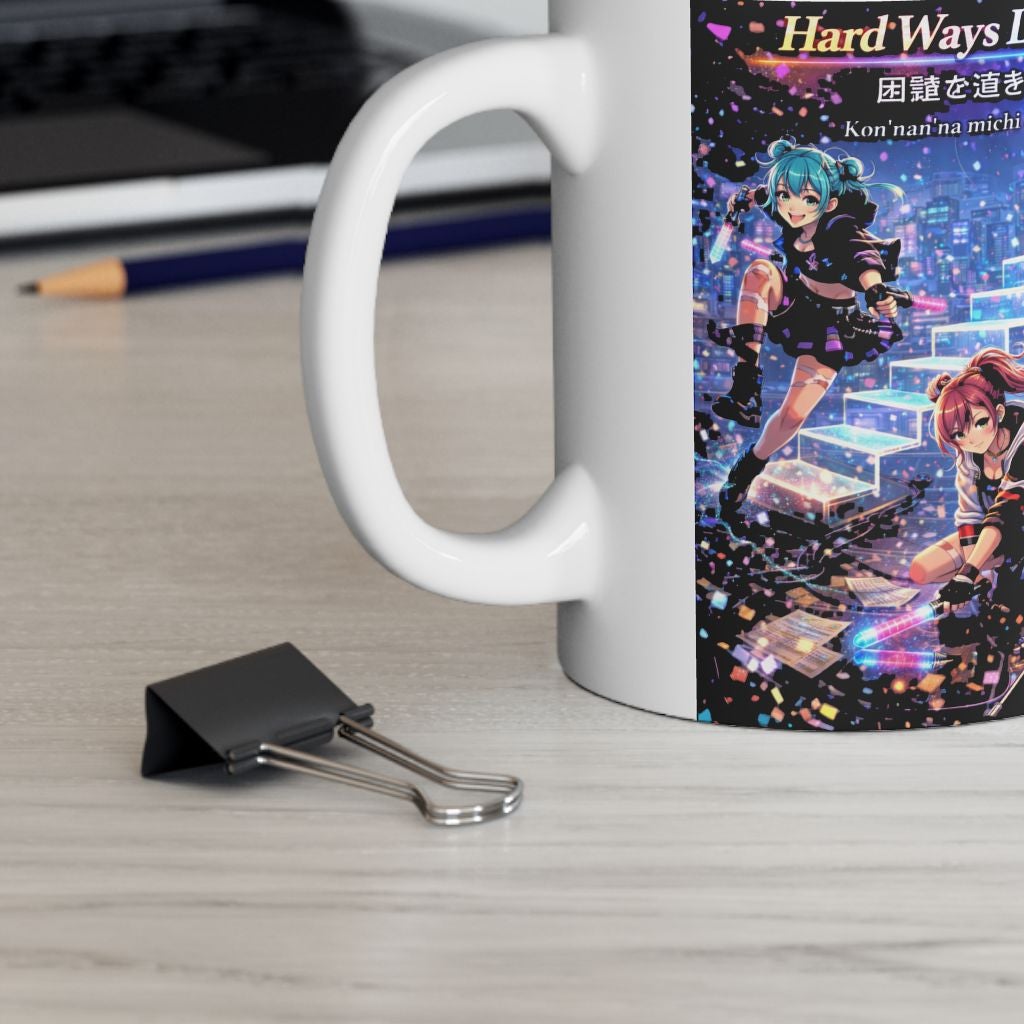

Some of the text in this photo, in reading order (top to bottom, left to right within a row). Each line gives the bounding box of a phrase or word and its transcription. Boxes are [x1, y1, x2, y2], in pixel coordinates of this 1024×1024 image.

[778, 14, 889, 53] Hard
[898, 13, 1000, 59] Ways
[844, 118, 962, 138] Kon'nan'na
[967, 113, 1021, 133] michi
